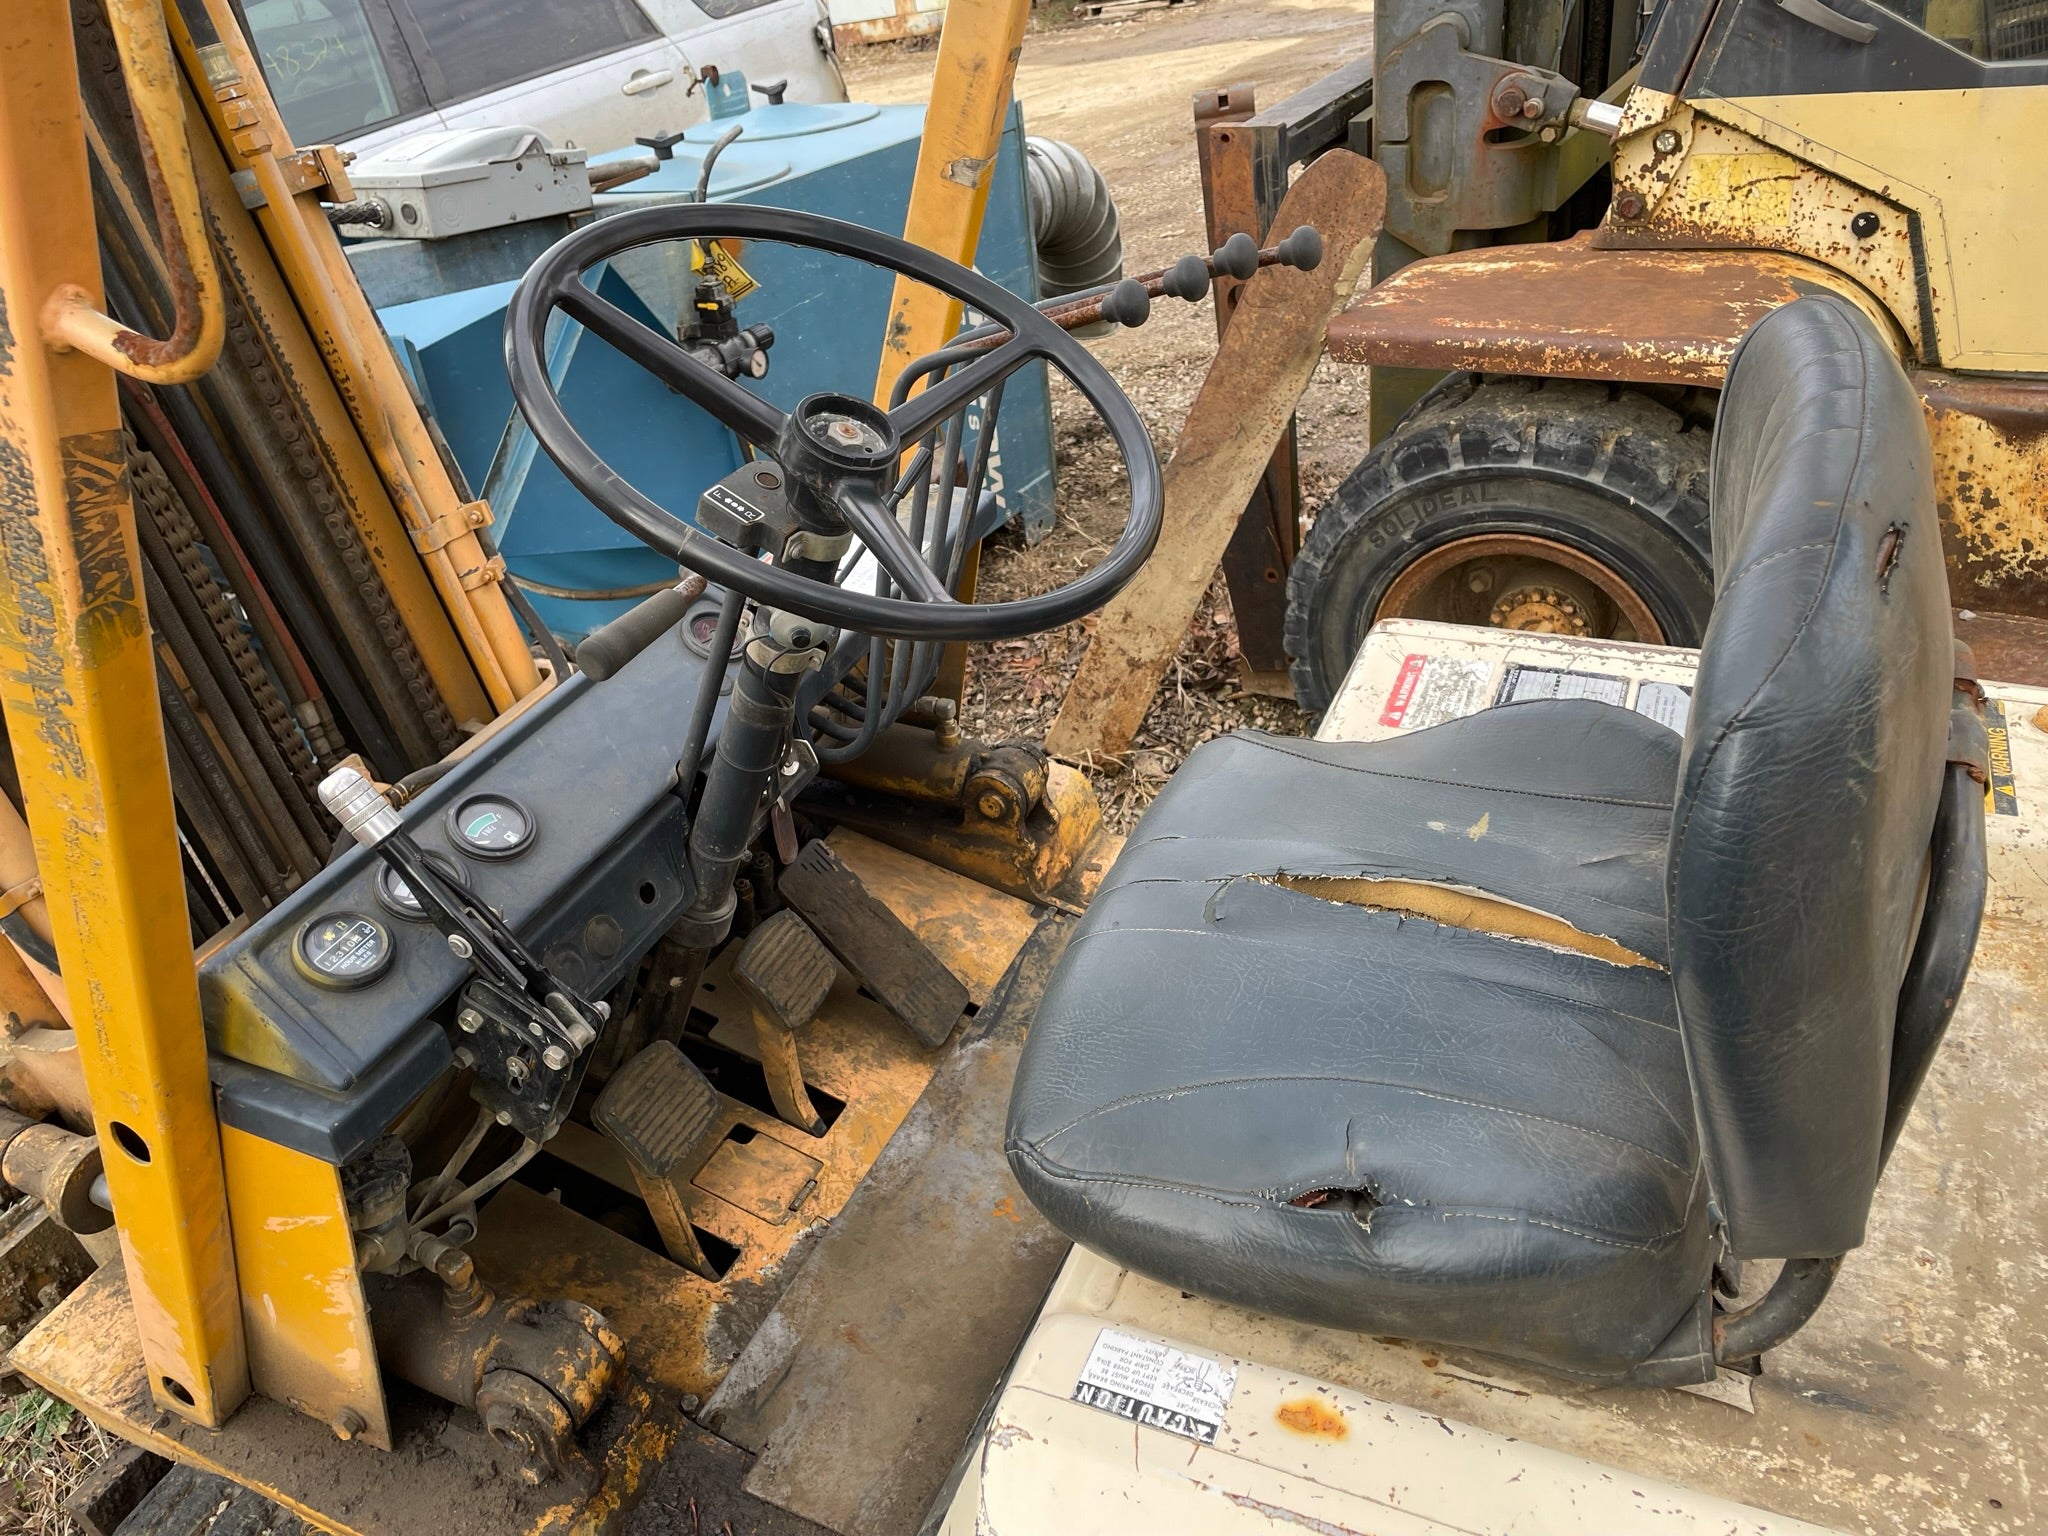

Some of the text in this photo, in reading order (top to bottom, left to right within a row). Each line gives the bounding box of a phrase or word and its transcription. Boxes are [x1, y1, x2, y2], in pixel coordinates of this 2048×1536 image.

[713, 490, 722, 499] F
[744, 510, 756, 519] R
[1369, 483, 1498, 549] SOLIDEAL
[1394, 671, 1418, 707] WARNING
[1988, 727, 2012, 776] WARNING
[340, 954, 357, 970] HOUR
[355, 938, 375, 957] METER
[1119, 1356, 1133, 1365] FOR
[1129, 1351, 1164, 1366] CONSTANT
[1113, 1363, 1130, 1373] OVER
[1134, 1361, 1150, 1370] GRIP
[1111, 1371, 1129, 1381] MUST
[1142, 1372, 1158, 1382] KEPT
[1109, 1379, 1138, 1393] PARKING
[1131, 1378, 1155, 1390] EFFORT
[1139, 1389, 1151, 1397] THE
[1077, 1383, 1188, 1437] CAUTION
